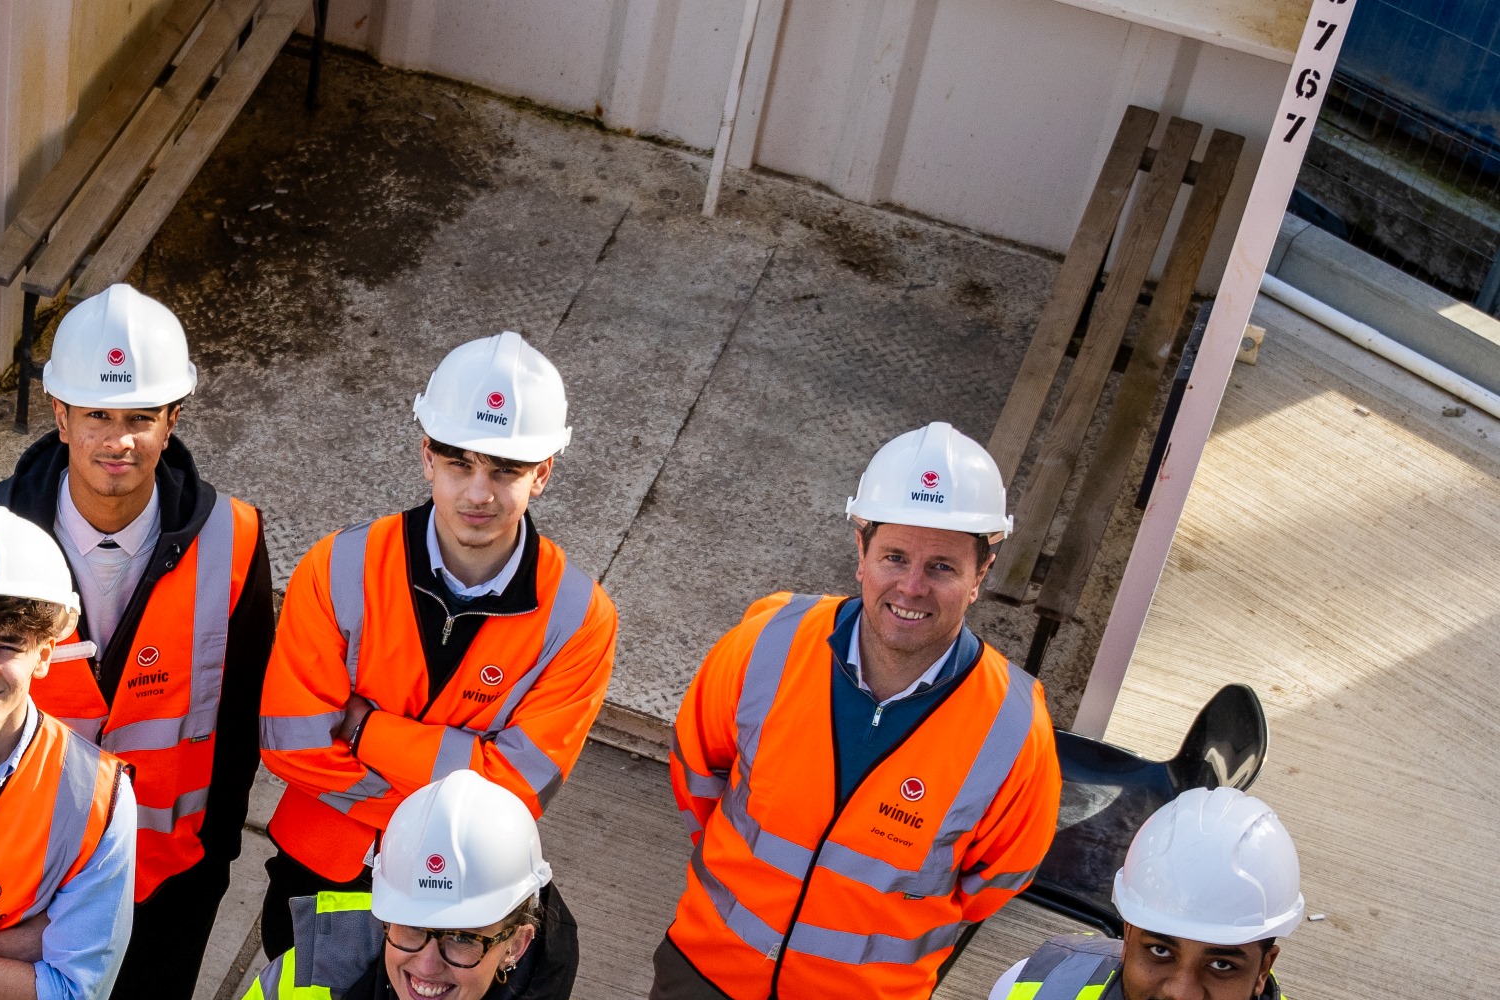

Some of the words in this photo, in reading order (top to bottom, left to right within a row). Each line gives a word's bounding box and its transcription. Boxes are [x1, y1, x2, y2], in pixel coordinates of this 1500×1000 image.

[1283, 0, 1348, 143] 767
[100, 371, 132, 383] winvic
[476, 410, 508, 426] winvic
[911, 490, 944, 504] winvic
[127, 669, 169, 689] winvic
[135, 688, 164, 698] VISITOR
[462, 688, 500, 703] winvi
[879, 802, 924, 829] winvic
[870, 826, 885, 837] Joe
[419, 876, 453, 890] winvic
